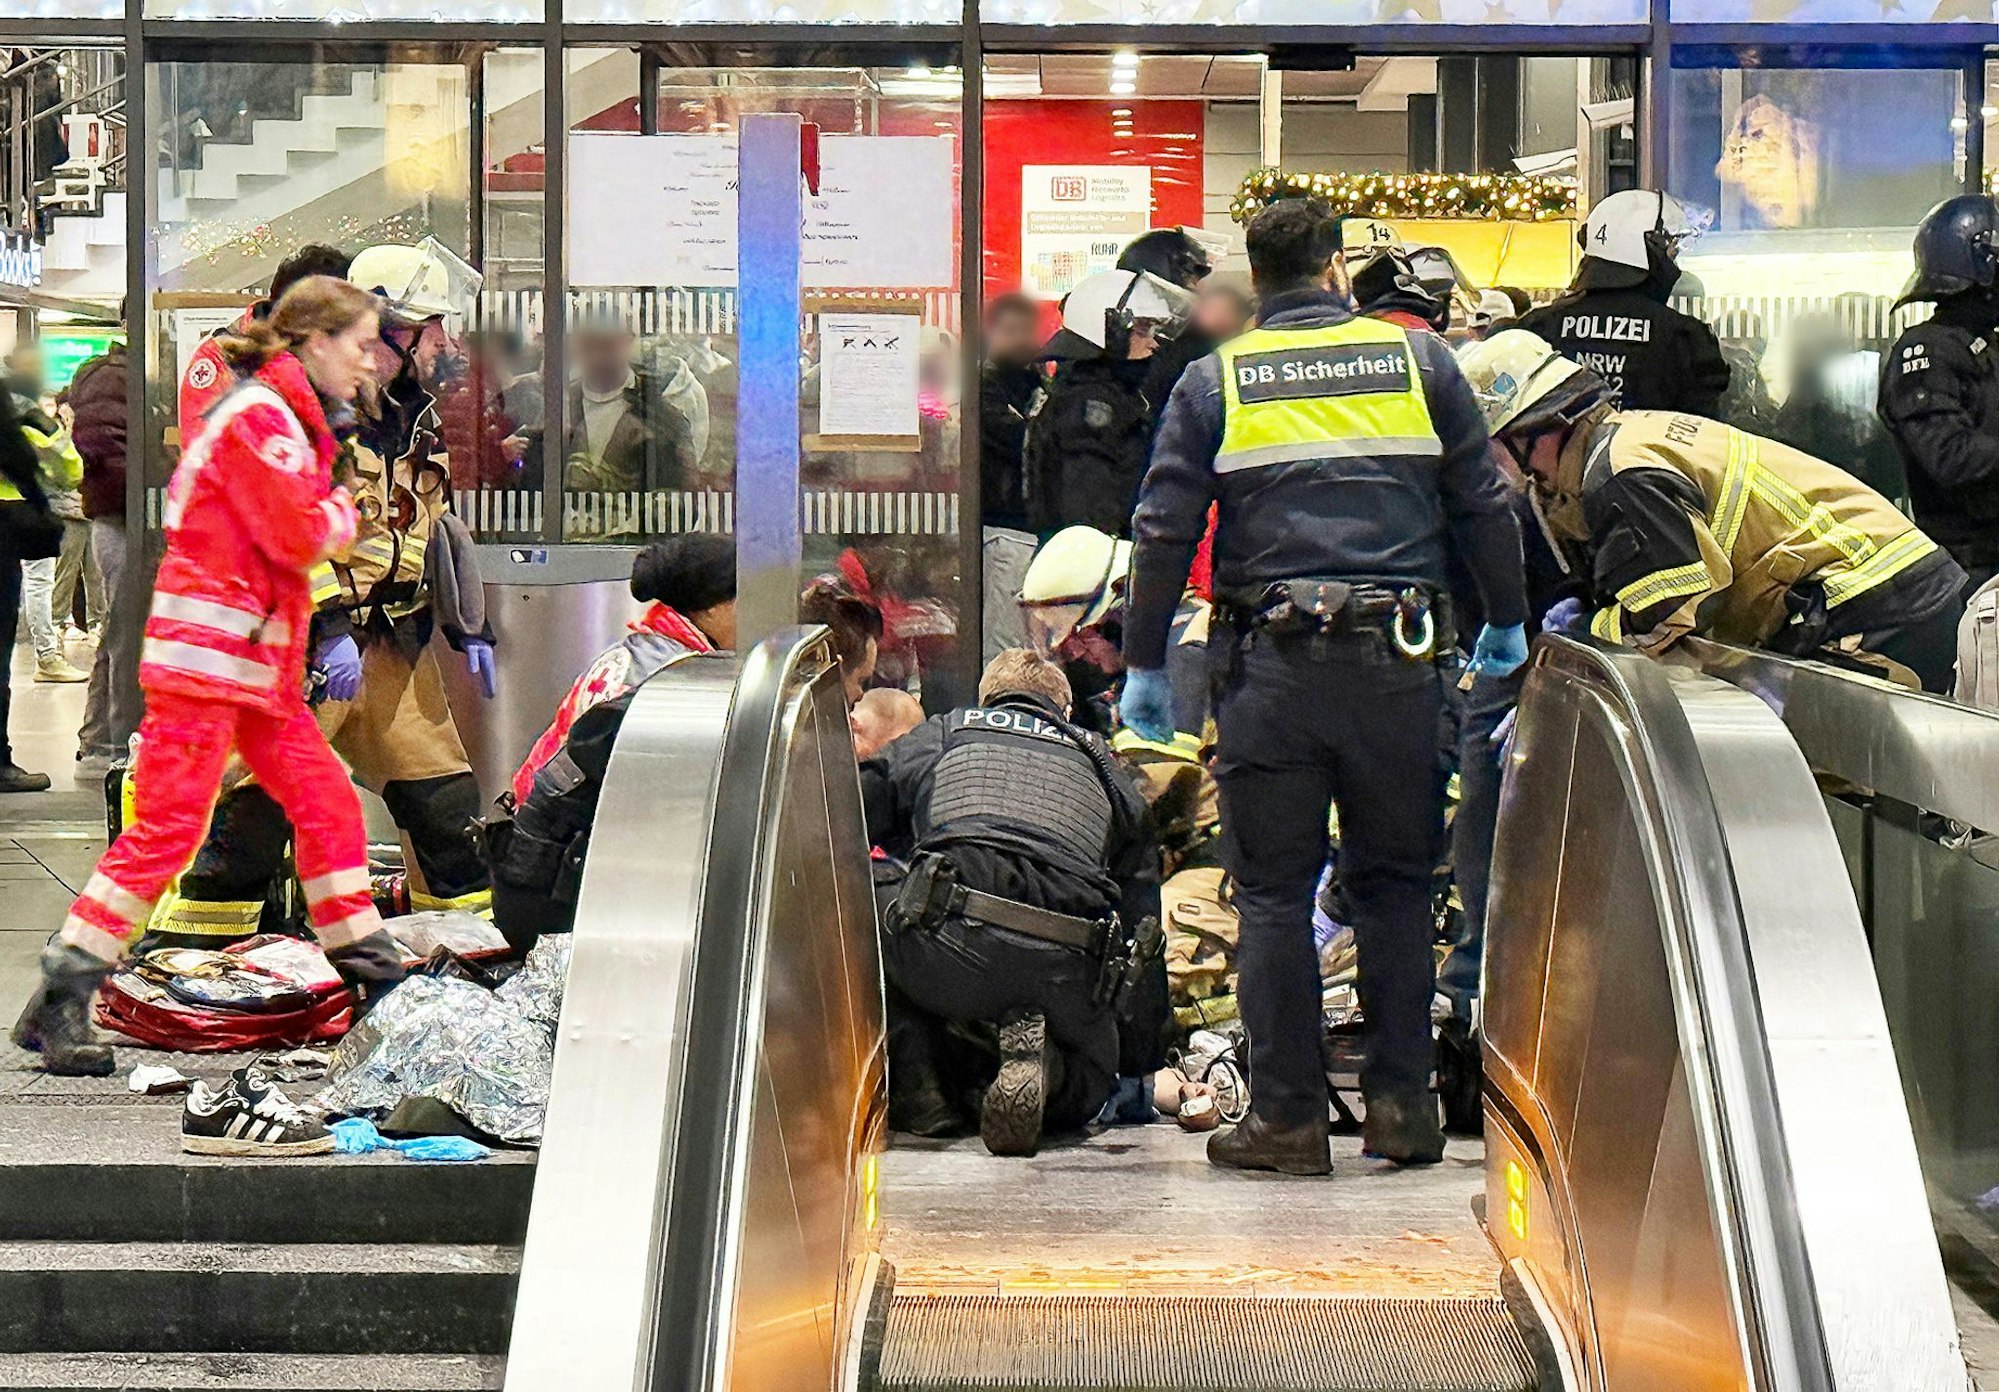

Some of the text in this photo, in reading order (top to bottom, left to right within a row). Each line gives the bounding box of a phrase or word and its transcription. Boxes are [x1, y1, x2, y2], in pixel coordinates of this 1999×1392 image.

[1055, 179, 1084, 199] DB
[1366, 223, 1390, 242] 14
[1595, 224, 1608, 245] 4
[1561, 315, 1651, 342] POLIZEI
[1238, 354, 1407, 387] DB Sicherheit
[1576, 351, 1626, 374] NRW
